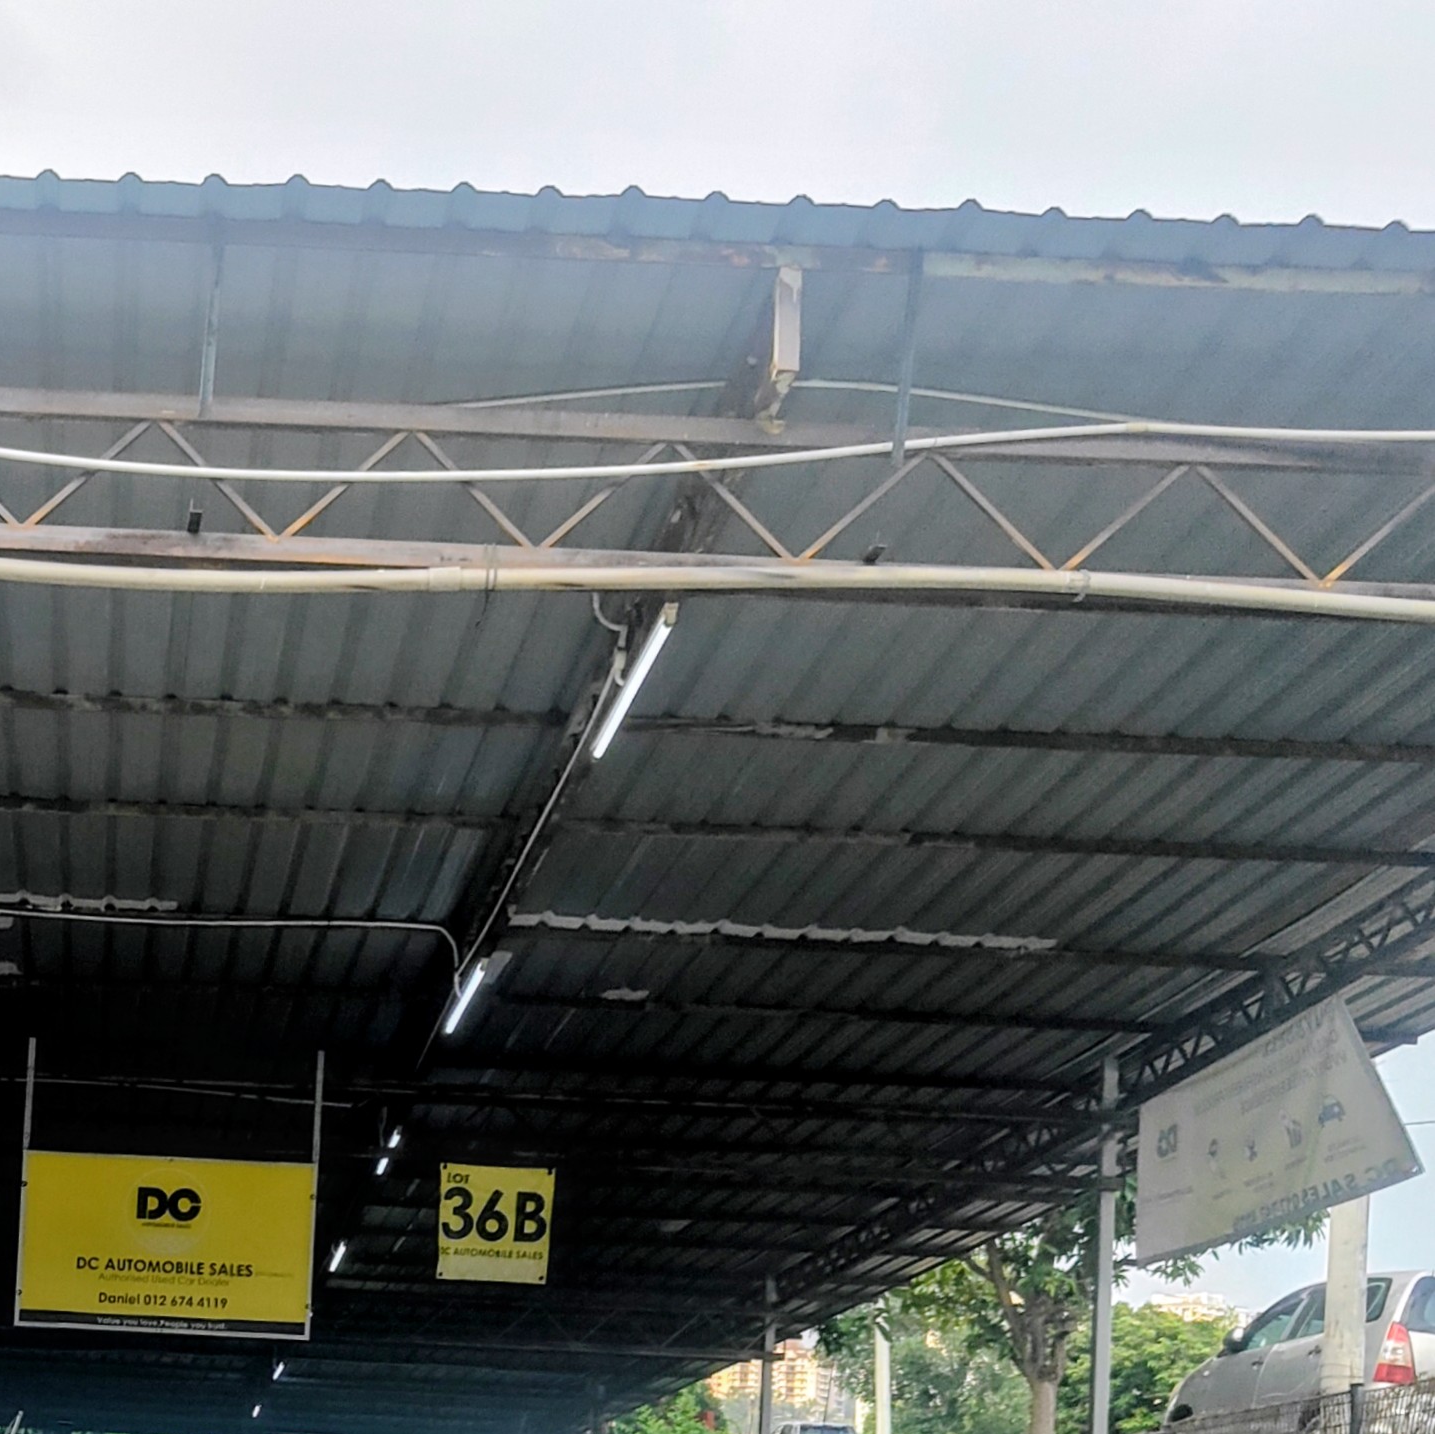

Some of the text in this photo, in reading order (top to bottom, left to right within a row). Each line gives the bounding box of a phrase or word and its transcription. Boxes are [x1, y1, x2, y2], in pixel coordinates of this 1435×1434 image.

[447, 1173, 470, 1184] LOT
[136, 1186, 202, 1222] DC
[442, 1186, 547, 1242] 36B
[453, 1247, 513, 1259] AUTOMOBILE
[516, 1249, 544, 1260] SALES
[76, 1257, 100, 1270] DC
[104, 1258, 204, 1275] AUTOMOBILE
[209, 1262, 253, 1277] SALES
[98, 1292, 229, 1309] Daniel 012 674 4119
